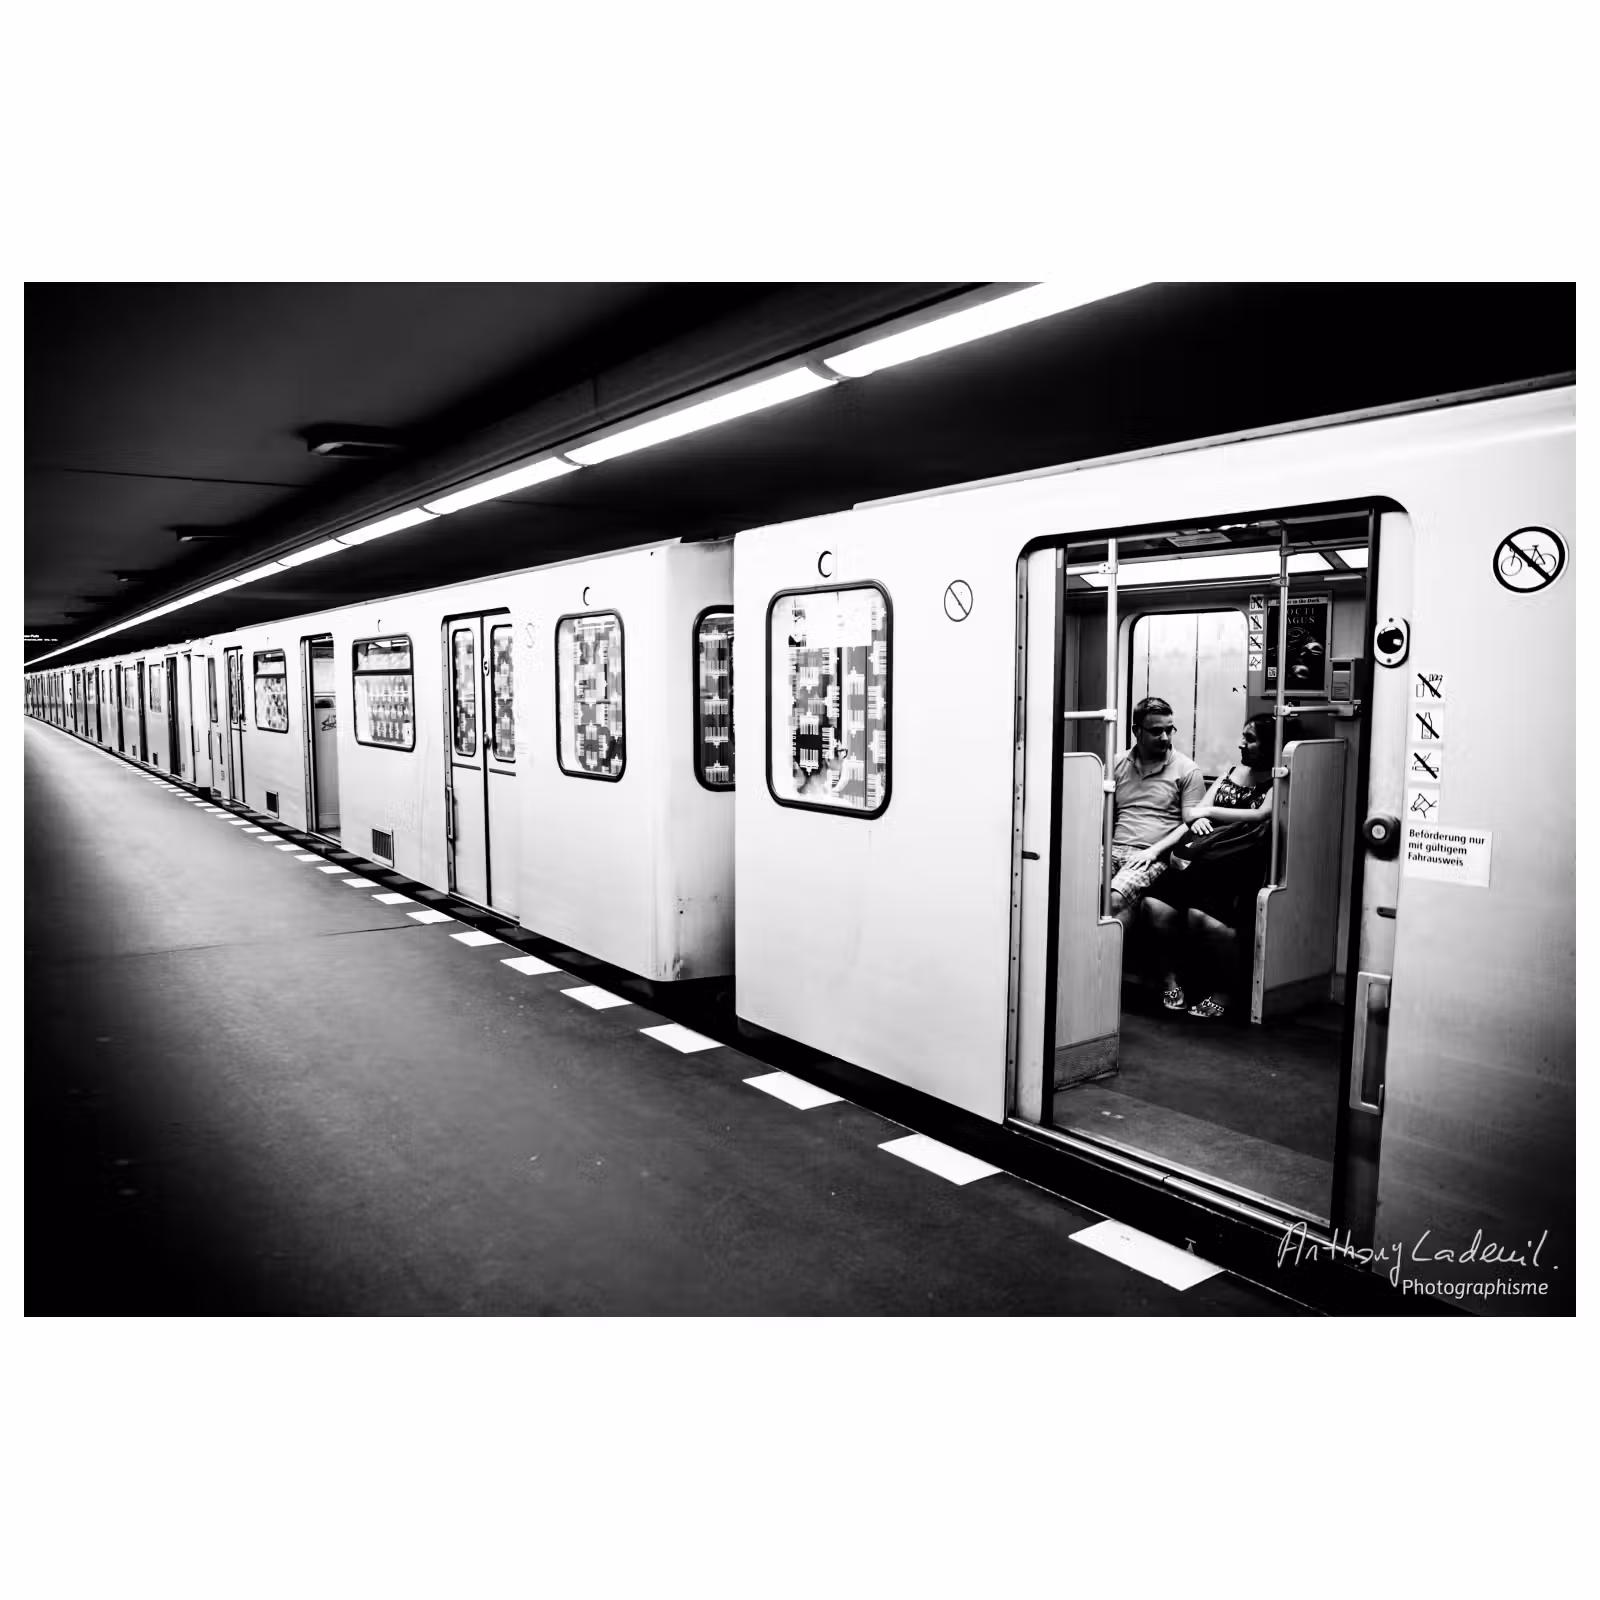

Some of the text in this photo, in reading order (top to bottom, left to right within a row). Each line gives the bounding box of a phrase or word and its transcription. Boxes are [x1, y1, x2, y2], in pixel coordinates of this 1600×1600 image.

[1409, 828, 1486, 845] Beförderung nur
[1408, 841, 1467, 855] mit gültigem
[1408, 852, 1464, 866] Fahrausweis
